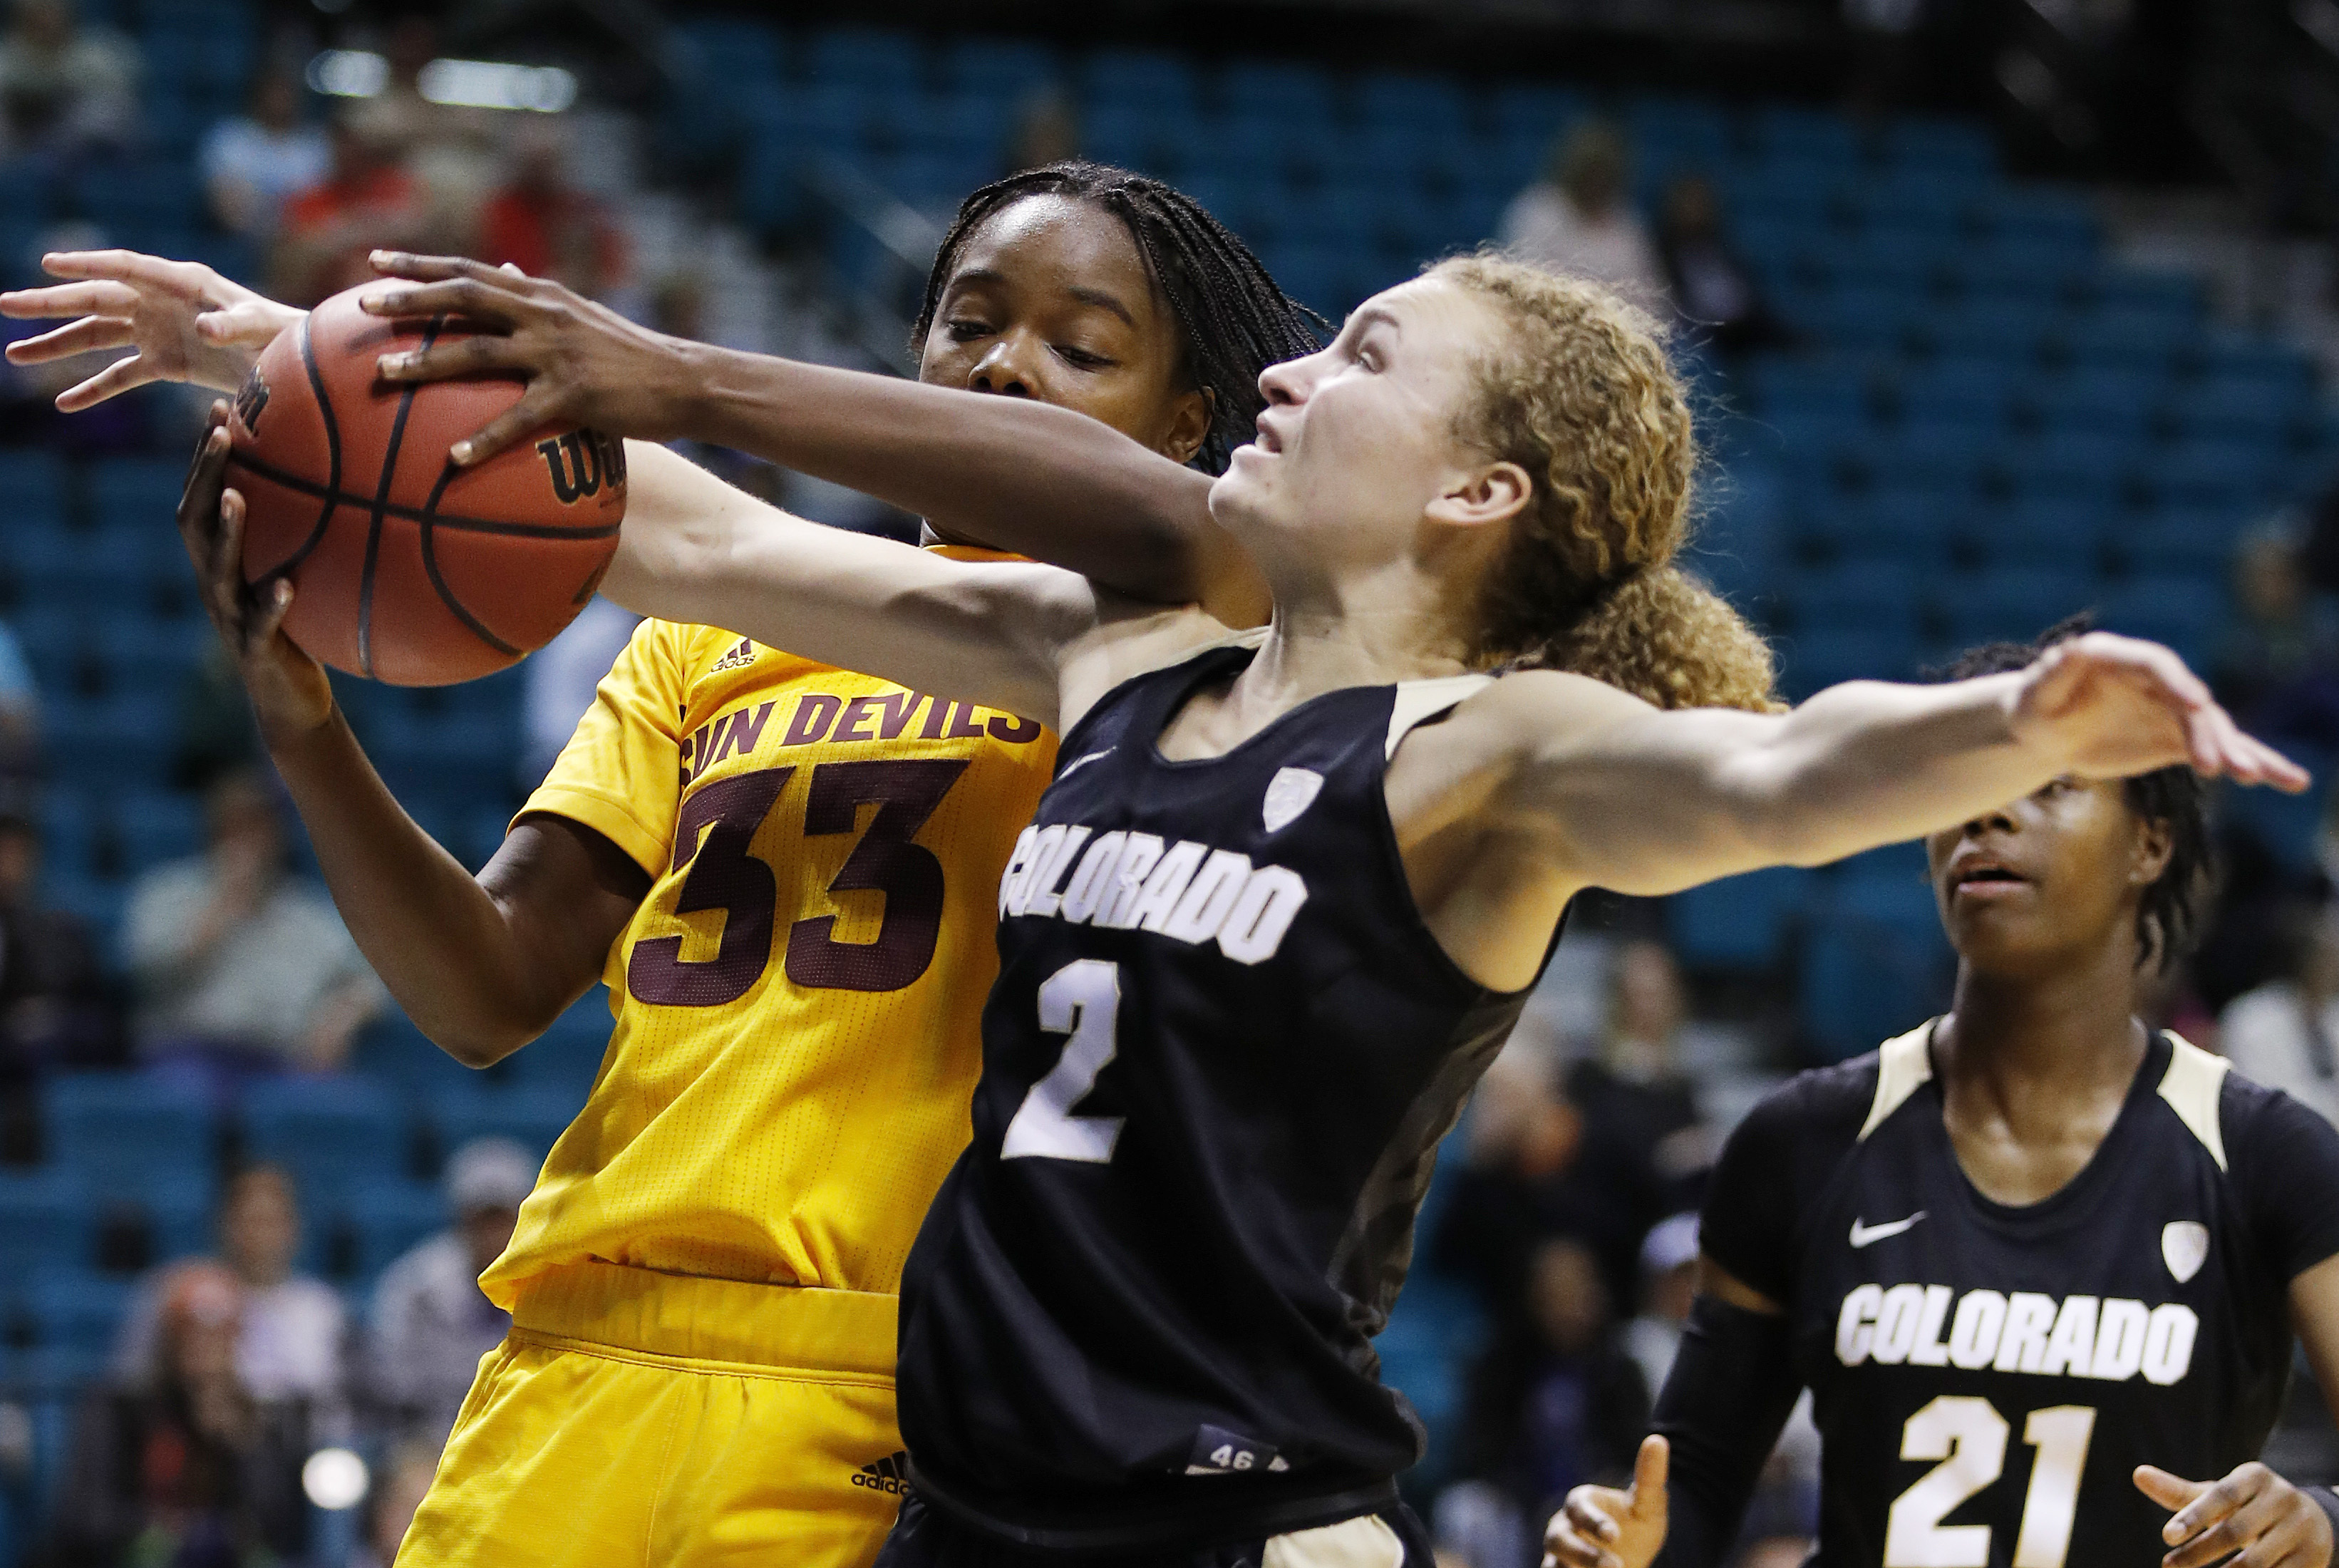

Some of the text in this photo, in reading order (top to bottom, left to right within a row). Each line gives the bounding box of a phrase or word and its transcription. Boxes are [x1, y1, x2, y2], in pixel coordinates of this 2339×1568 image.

[783, 689, 1041, 744] DEVILS
[628, 758, 972, 1007] 33
[998, 824, 1309, 966] COLORADO
[1000, 958, 1127, 1165] 2
[1835, 1283, 2199, 1386] COLORADO
[851, 1473, 910, 1495] adida
[1209, 1443, 1255, 1471] 46
[1883, 1395, 2098, 1568] 21
